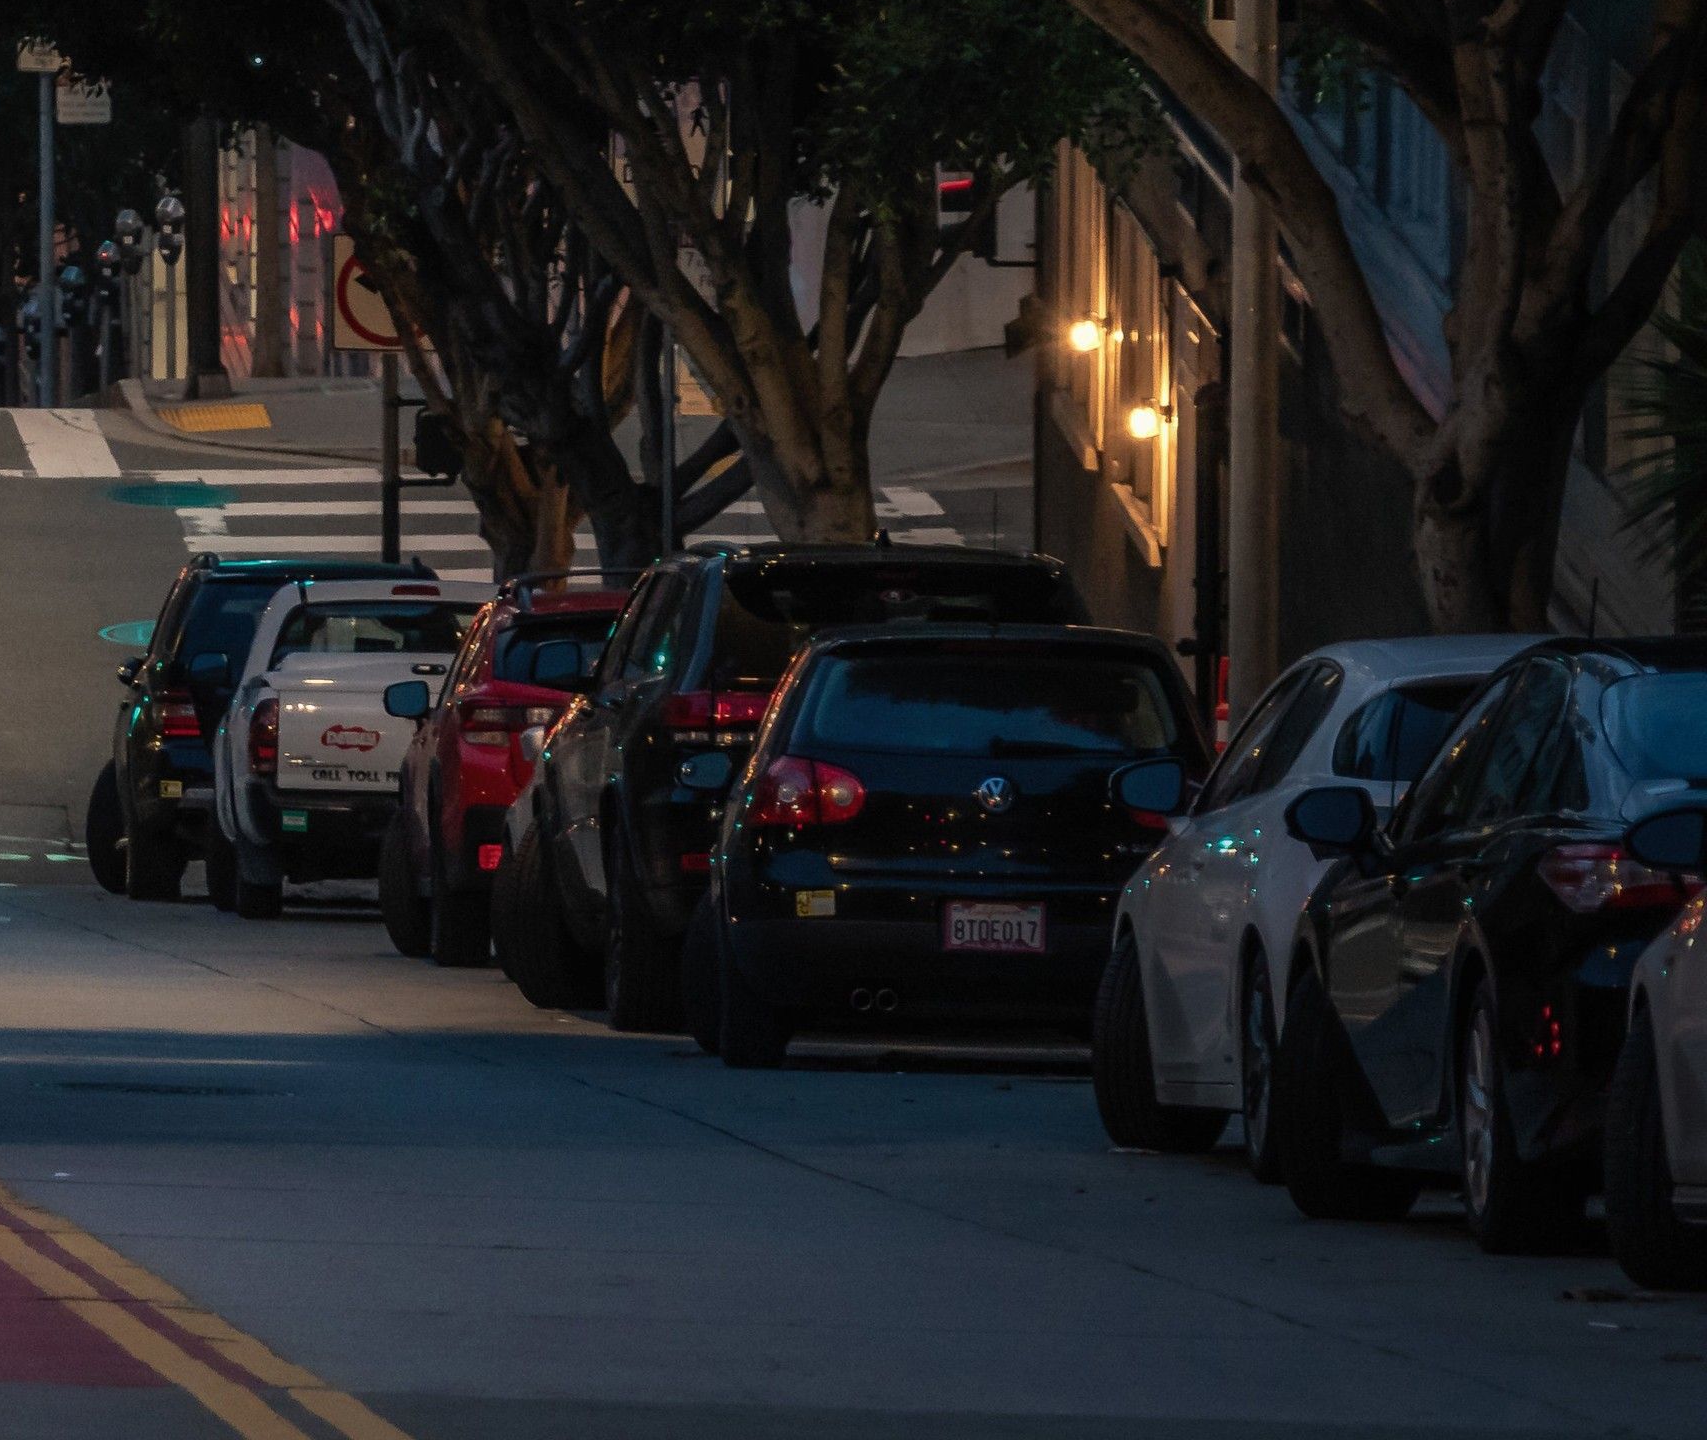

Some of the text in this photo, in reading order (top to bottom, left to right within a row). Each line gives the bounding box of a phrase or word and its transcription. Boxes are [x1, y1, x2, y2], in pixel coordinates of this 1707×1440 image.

[312, 769, 400, 782] CALL TOLL FR
